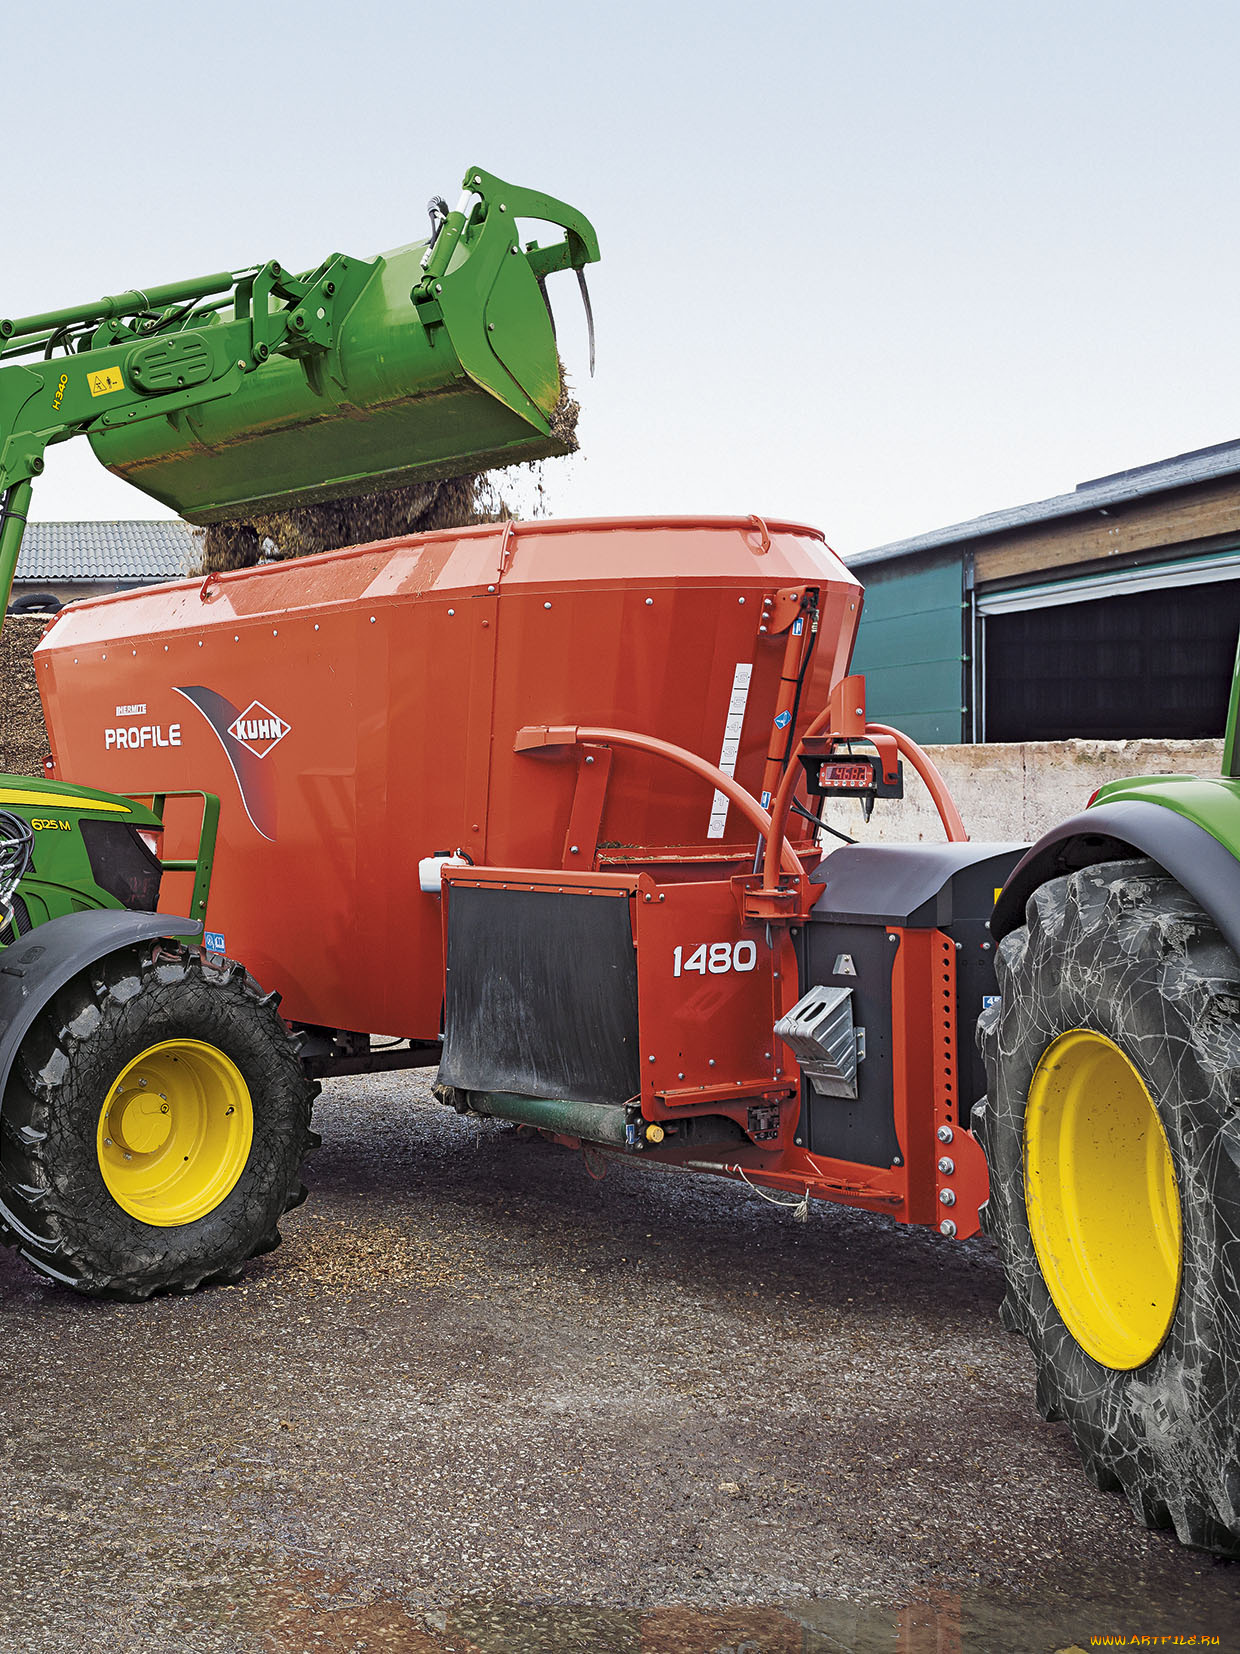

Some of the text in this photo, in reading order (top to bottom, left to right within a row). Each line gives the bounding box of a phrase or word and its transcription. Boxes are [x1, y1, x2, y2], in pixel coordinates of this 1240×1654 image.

[52, 374, 68, 411] H340
[104, 723, 182, 750] PROFILE
[236, 718, 281, 740] KUHN
[673, 940, 757, 977] 1480
